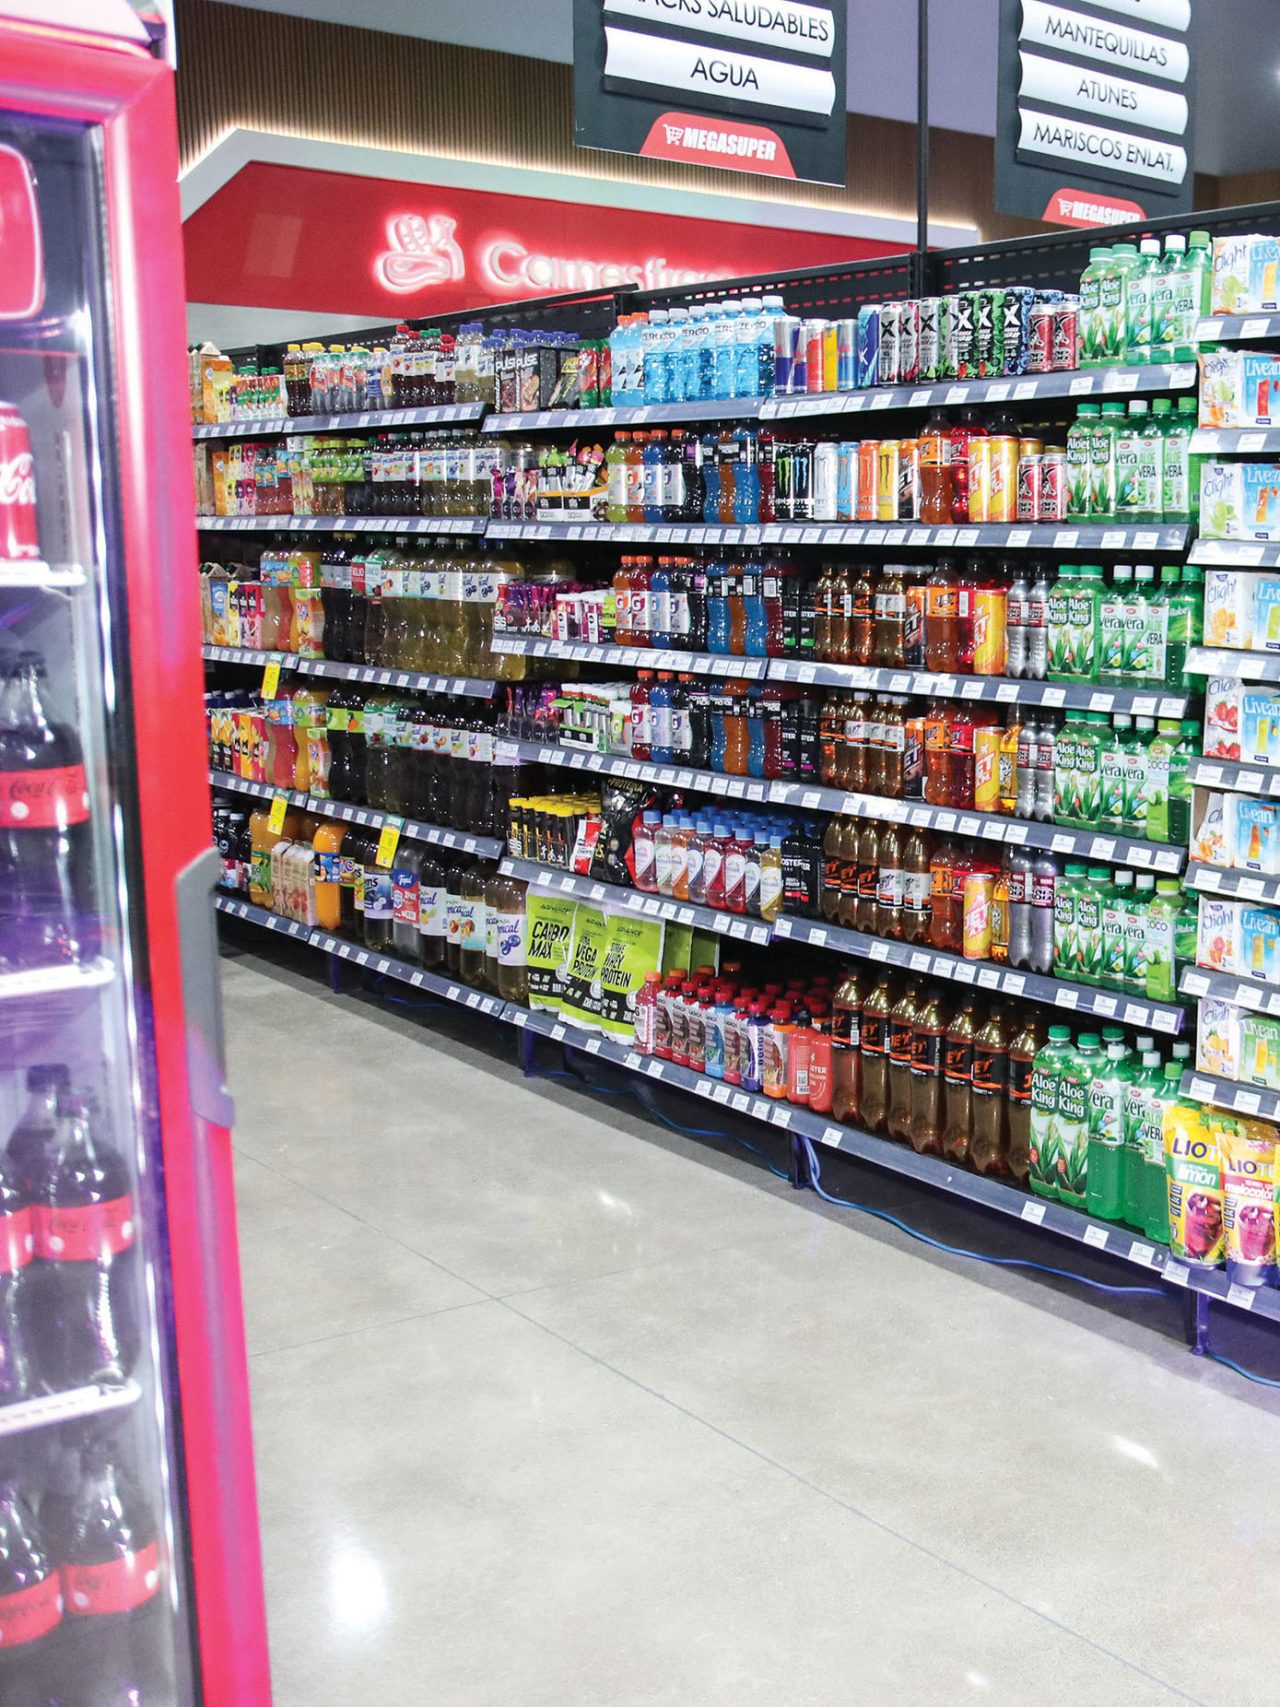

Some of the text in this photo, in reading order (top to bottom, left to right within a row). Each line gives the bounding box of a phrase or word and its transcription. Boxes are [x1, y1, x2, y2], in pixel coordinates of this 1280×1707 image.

[707, 0, 829, 41] SALUDABLES
[1045, 16, 1167, 67] MANTEQUILLAS
[691, 57, 759, 89] AGUA
[1077, 79, 1137, 110] ATUNES
[683, 127, 776, 160] MEGASUPER
[1034, 123, 1173, 172] MARISCOS ENLAT.
[1174, 300, 1194, 312] VERA
[1067, 436, 1088, 450] Aloe
[1138, 465, 1157, 478] VERA
[1165, 464, 1183, 478] VERA
[1068, 599, 1089, 612] Aloe
[1069, 611, 1089, 625] King
[1056, 742, 1075, 756] Aloe
[1075, 745, 1095, 758] Aloe
[1056, 755, 1075, 768] King
[1075, 757, 1095, 772] King
[1055, 896, 1073, 910] Aloe
[1078, 901, 1097, 914] Aloe
[1055, 908, 1073, 922] King
[1078, 913, 1098, 927] King
[1241, 916, 1278, 935] Livean
[528, 940, 553, 959] MAX
[576, 944, 597, 962] VEGA
[601, 967, 632, 987] PROTEIN
[1242, 1021, 1279, 1040] Livean
[1032, 1073, 1057, 1092] Aloe
[1032, 1087, 1058, 1108] King
[1058, 1083, 1085, 1101] Aloe
[1088, 1086, 1114, 1111] Vera
[1058, 1097, 1085, 1117] King
[1178, 1164, 1216, 1185] limón
